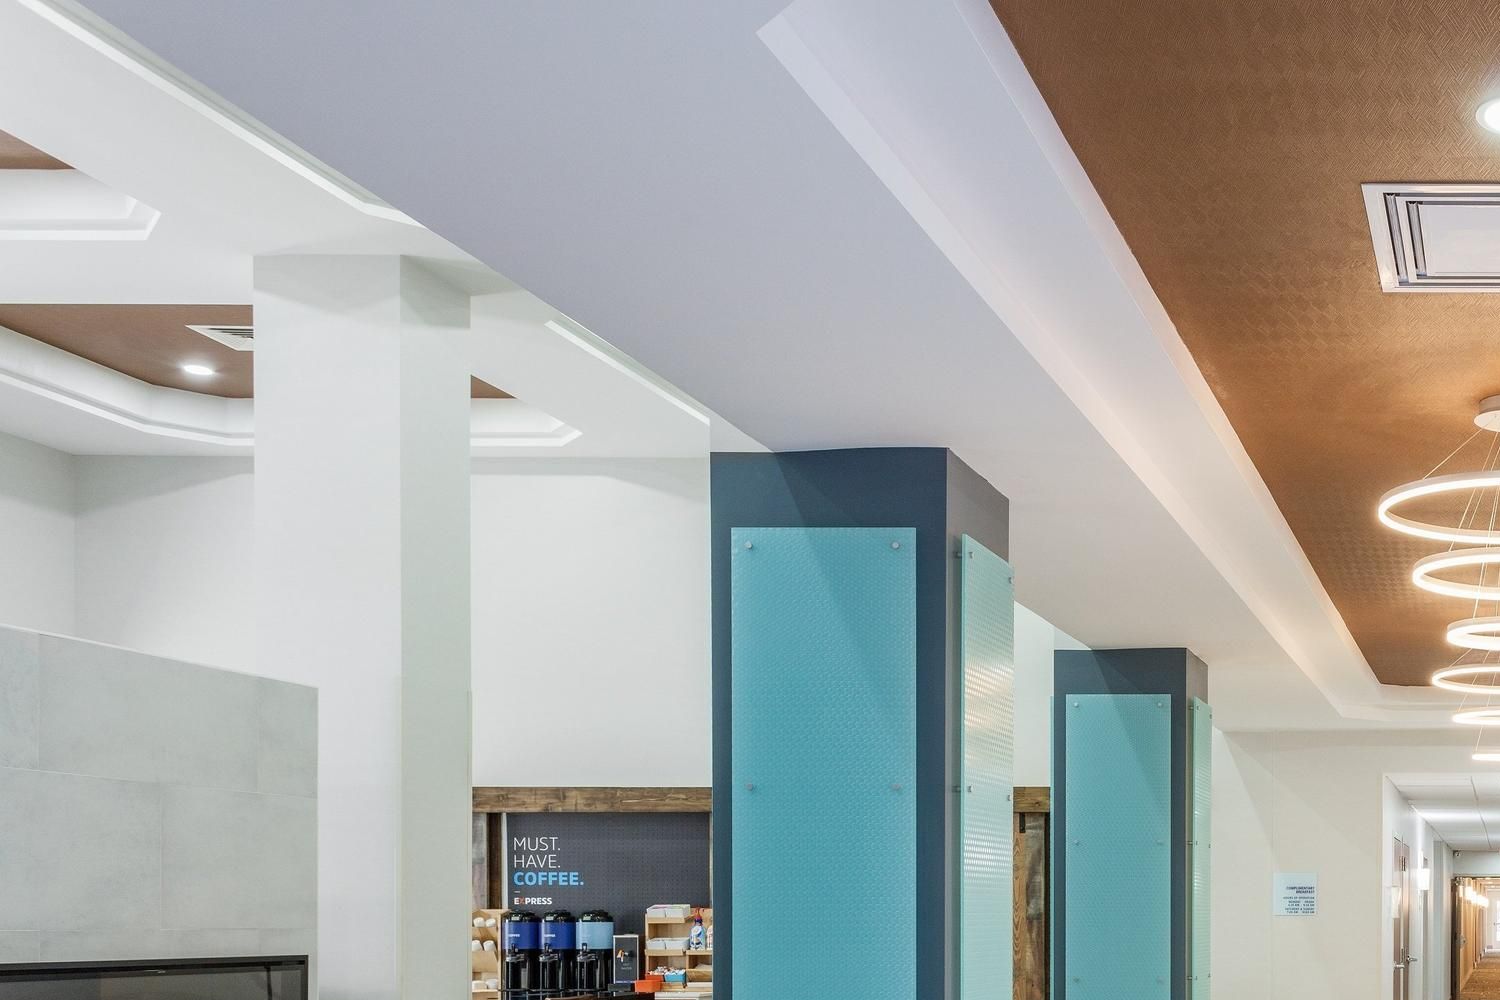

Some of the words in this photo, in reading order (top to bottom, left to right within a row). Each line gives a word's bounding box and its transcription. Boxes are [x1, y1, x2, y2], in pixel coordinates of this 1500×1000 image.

[514, 837, 561, 851] MUST.
[514, 854, 561, 868] HAVE.
[513, 871, 584, 886] COFFEE.
[514, 897, 553, 905] EXPRESS
